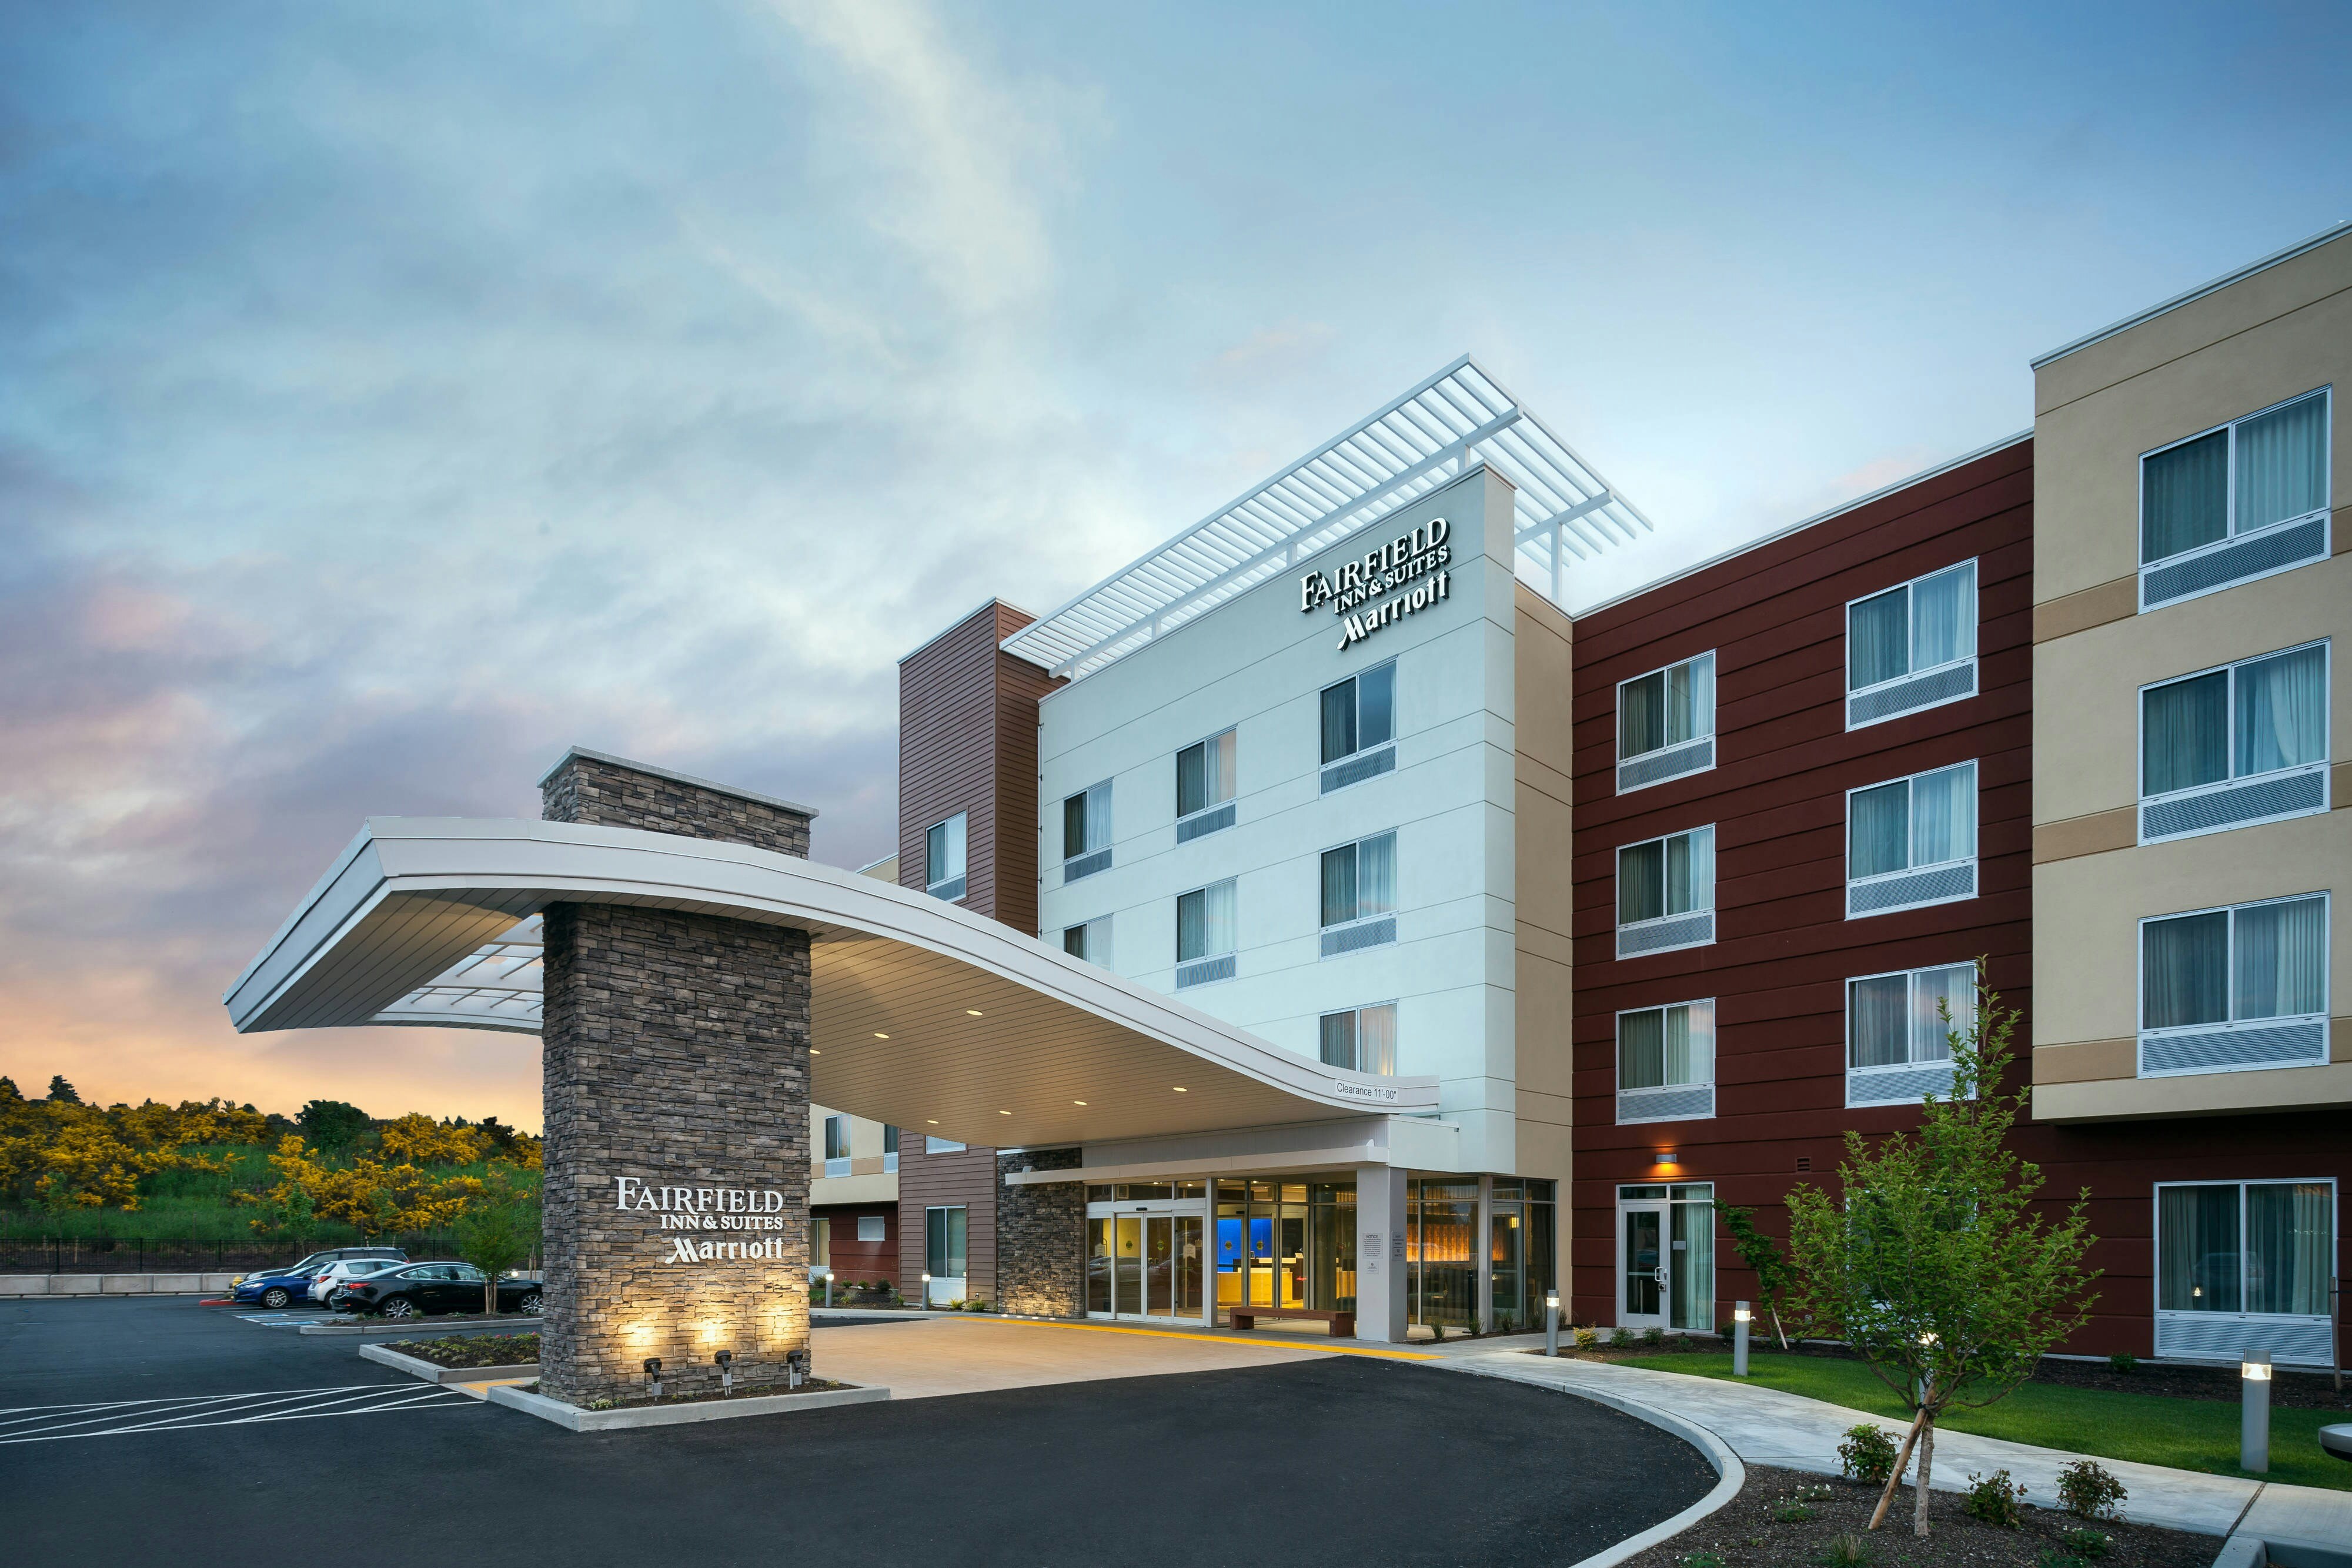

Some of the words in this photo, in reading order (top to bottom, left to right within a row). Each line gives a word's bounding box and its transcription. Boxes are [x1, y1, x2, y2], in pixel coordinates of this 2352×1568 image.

[1299, 517, 1449, 613] FAIRFIELD
[1333, 583, 1368, 615] INN
[1369, 579, 1384, 596] &
[1385, 544, 1449, 589] SUITES
[1337, 569, 1449, 650] Marriott
[1337, 1082, 1372, 1096] Clearance
[614, 1176, 783, 1215] FAIRFIELD
[660, 1215, 699, 1229] INN
[702, 1215, 718, 1229] &
[720, 1216, 783, 1230] SUITES
[664, 1237, 783, 1264] Marriott
